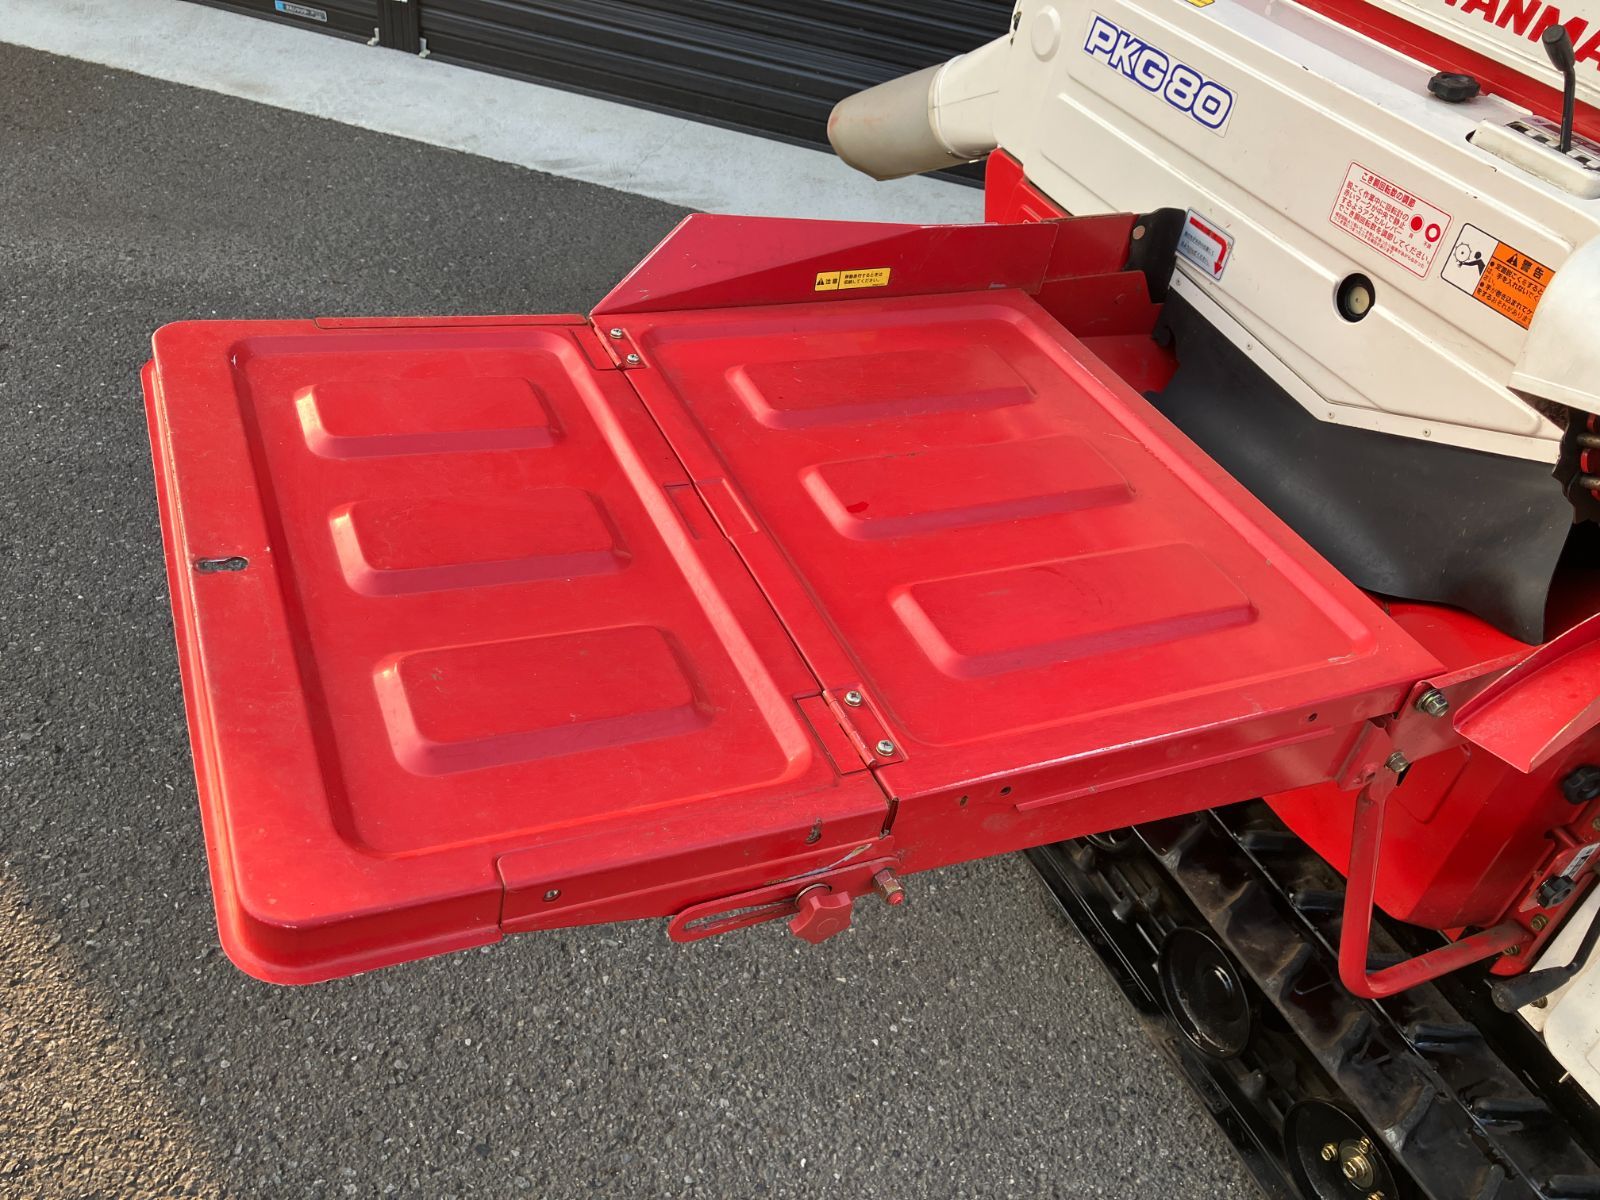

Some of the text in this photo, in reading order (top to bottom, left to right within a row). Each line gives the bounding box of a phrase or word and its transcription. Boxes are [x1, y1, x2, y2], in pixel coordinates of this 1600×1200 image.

[1444, 0, 1600, 72] ANMA
[1084, 16, 1233, 129] PKG80
[1520, 258, 1544, 280] 警告
